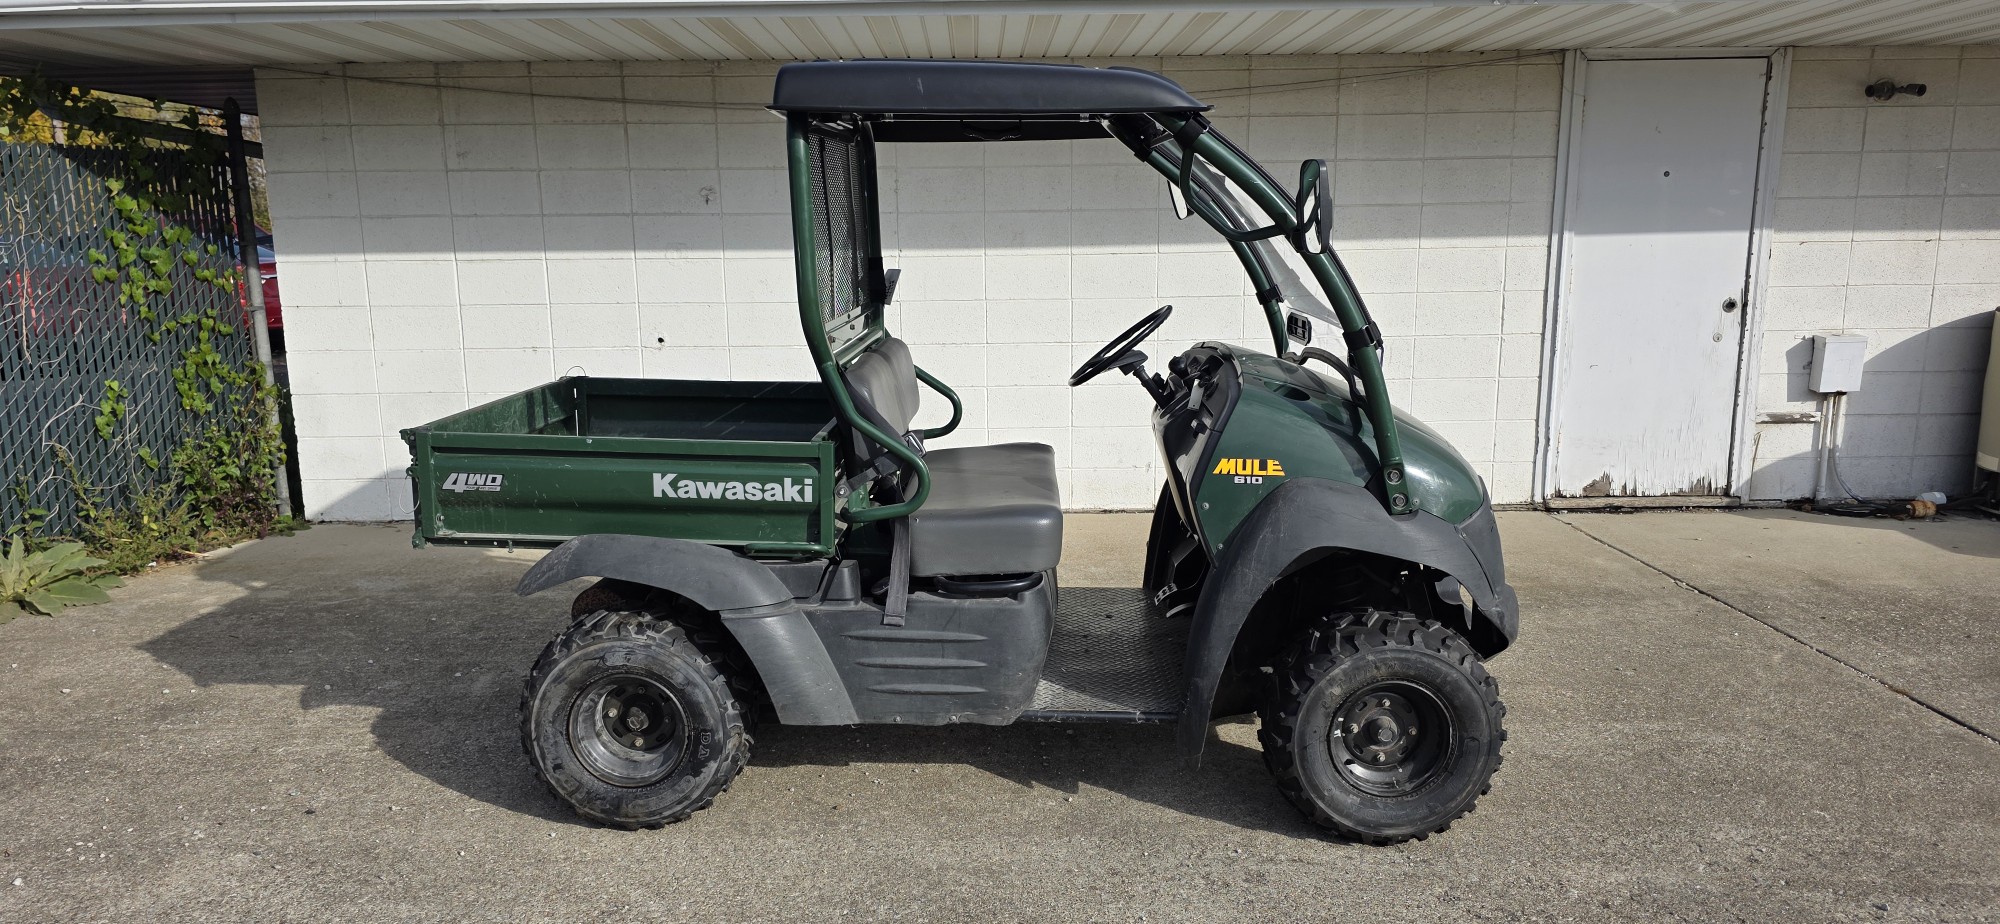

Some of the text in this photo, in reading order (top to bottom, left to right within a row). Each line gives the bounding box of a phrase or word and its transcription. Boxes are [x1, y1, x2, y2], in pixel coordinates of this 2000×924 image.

[1212, 458, 1286, 476] MULE
[442, 472, 503, 493] 4WD
[652, 472, 813, 503] Kawasaki
[1234, 475, 1263, 485] 610
